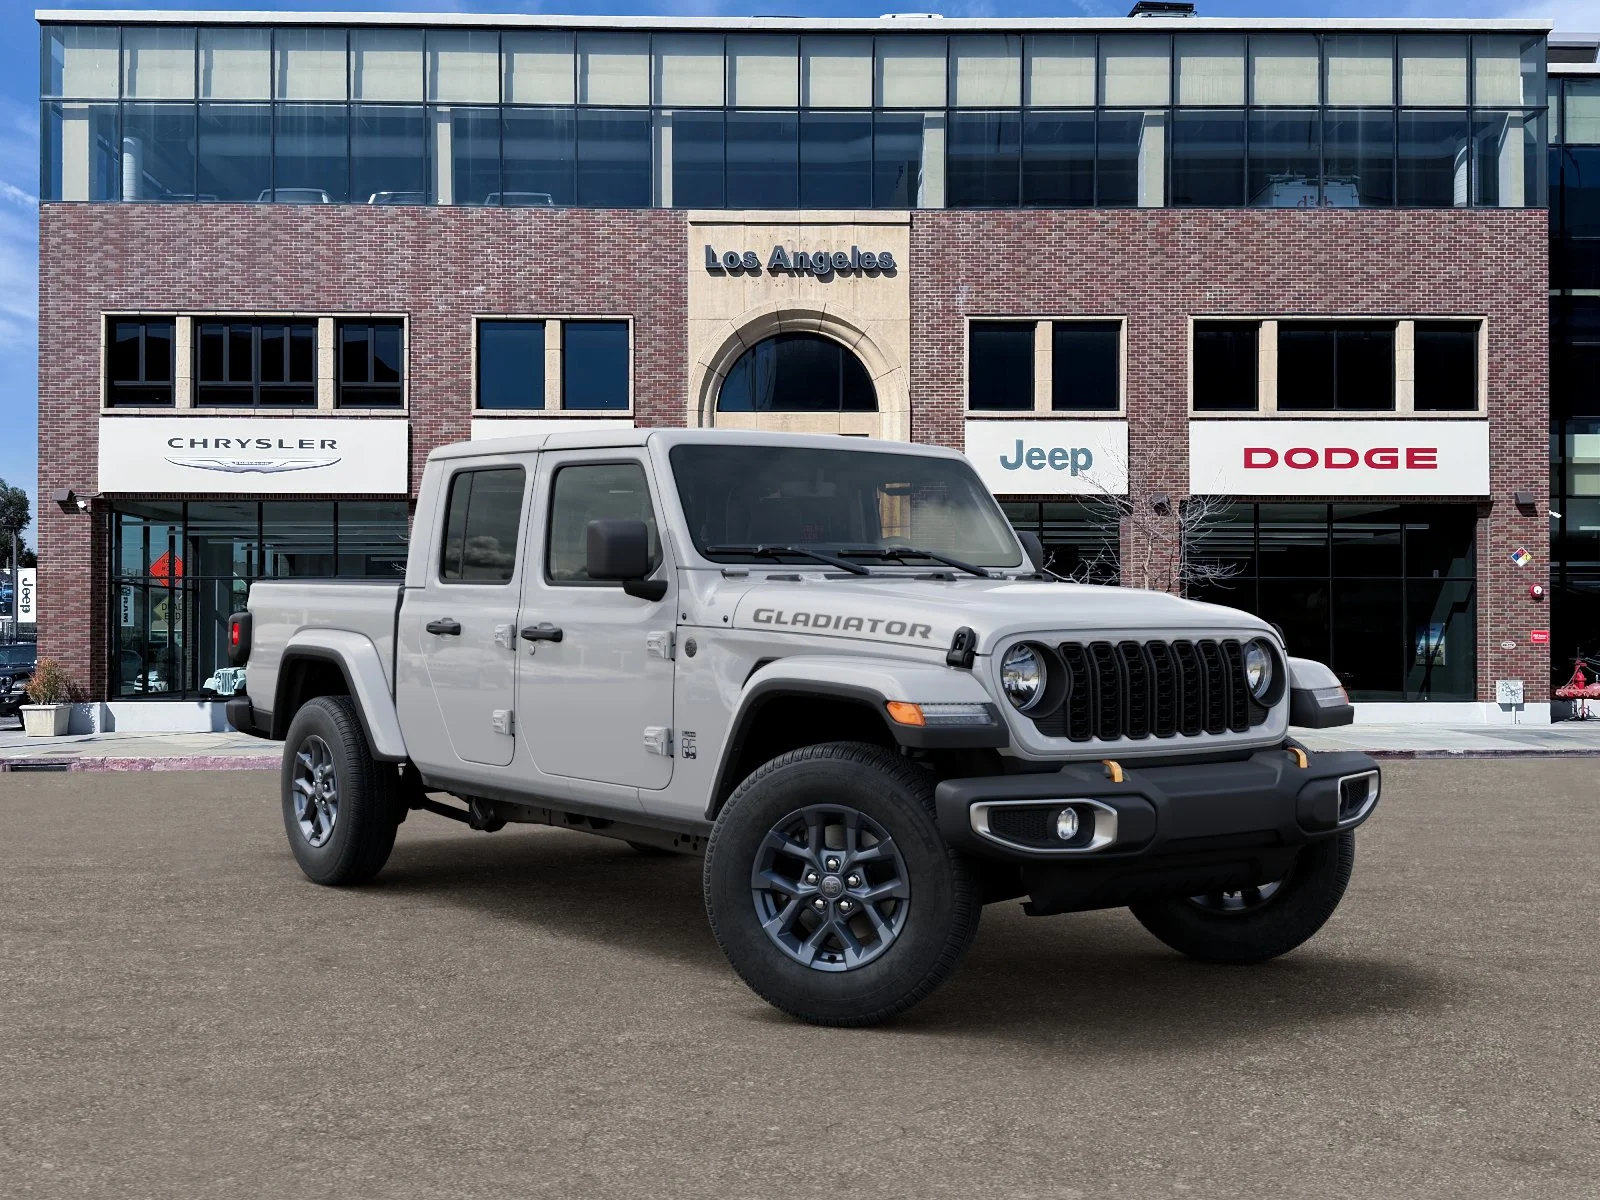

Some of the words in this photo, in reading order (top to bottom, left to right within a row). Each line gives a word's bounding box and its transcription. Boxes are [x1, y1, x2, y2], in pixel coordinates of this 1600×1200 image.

[705, 244, 758, 269] Los
[768, 244, 895, 275] Angeles
[168, 437, 338, 450] CHRYSLER
[1000, 439, 1093, 476] Jeep
[1244, 447, 1438, 469] DODGE
[19, 577, 34, 614] Jeep
[164, 612, 181, 620] ED
[753, 608, 933, 640] GLADIATOR
